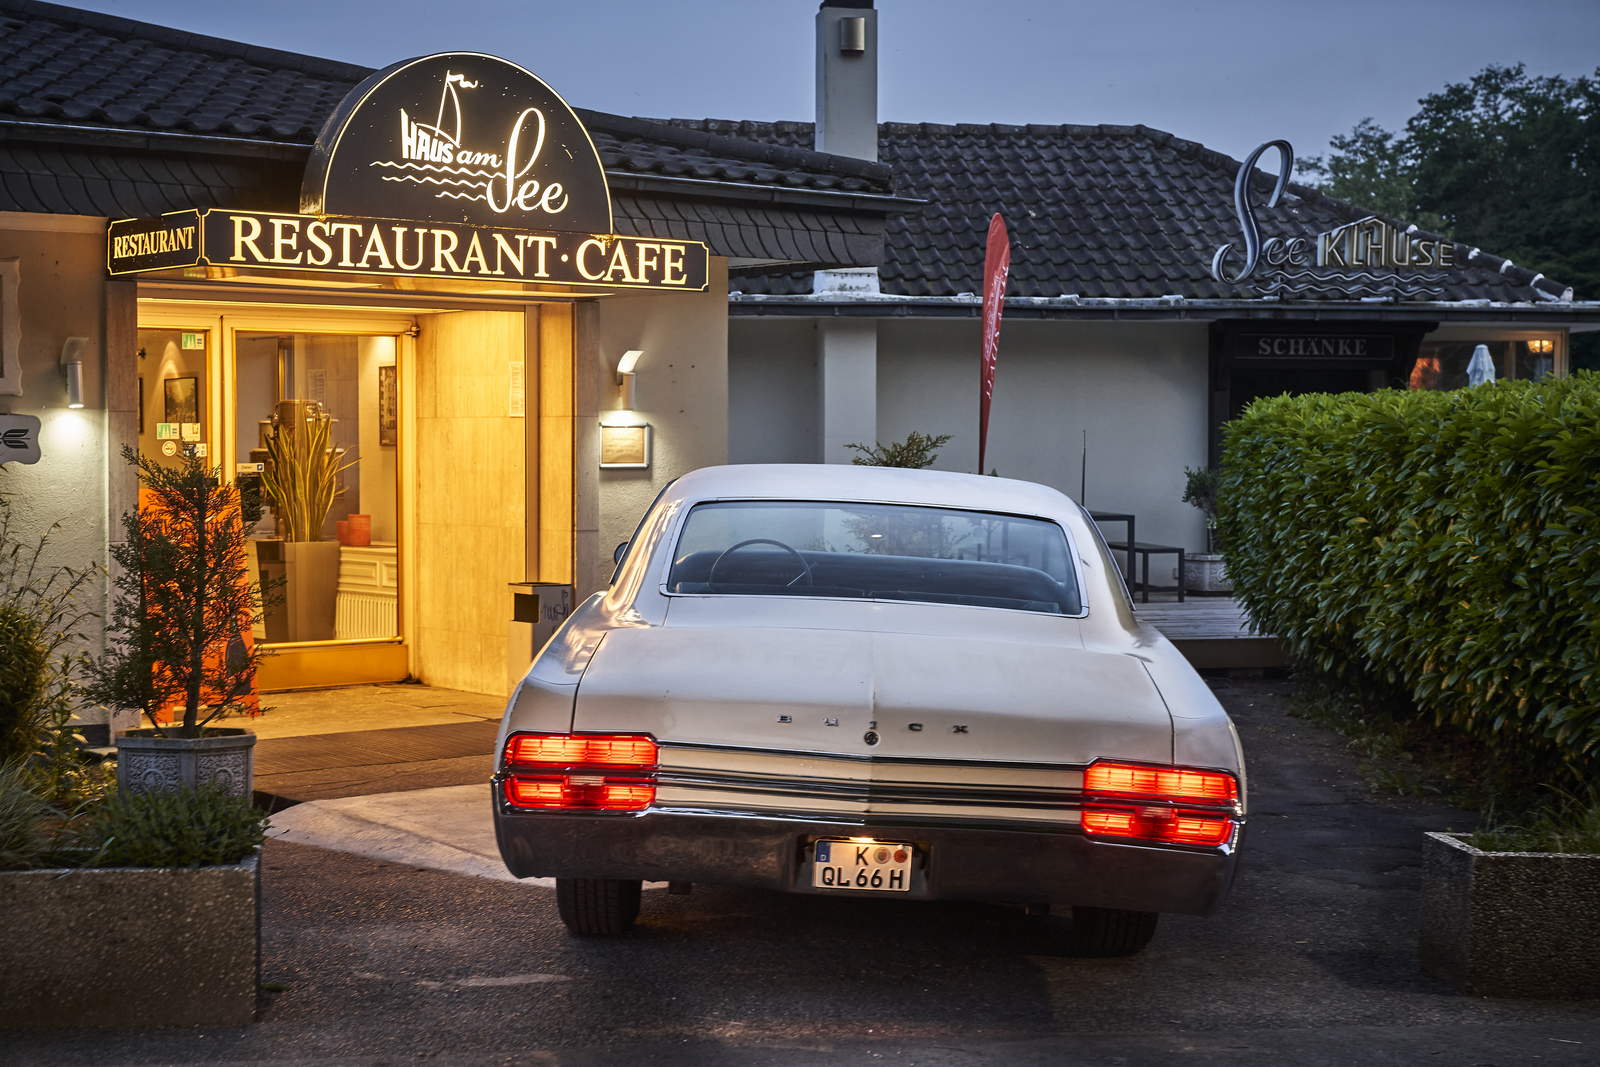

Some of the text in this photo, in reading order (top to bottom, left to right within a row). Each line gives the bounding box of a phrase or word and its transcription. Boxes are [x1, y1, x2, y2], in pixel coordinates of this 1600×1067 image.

[400, 107, 568, 213] HAUS am See
[1212, 139, 1308, 284] See
[113, 226, 196, 259] RESTAURANT
[229, 215, 688, 286] RESTAURANT CAFE
[1258, 337, 1368, 356] SCHÄNKE
[855, 846, 869, 866] K
[822, 866, 850, 887] QL
